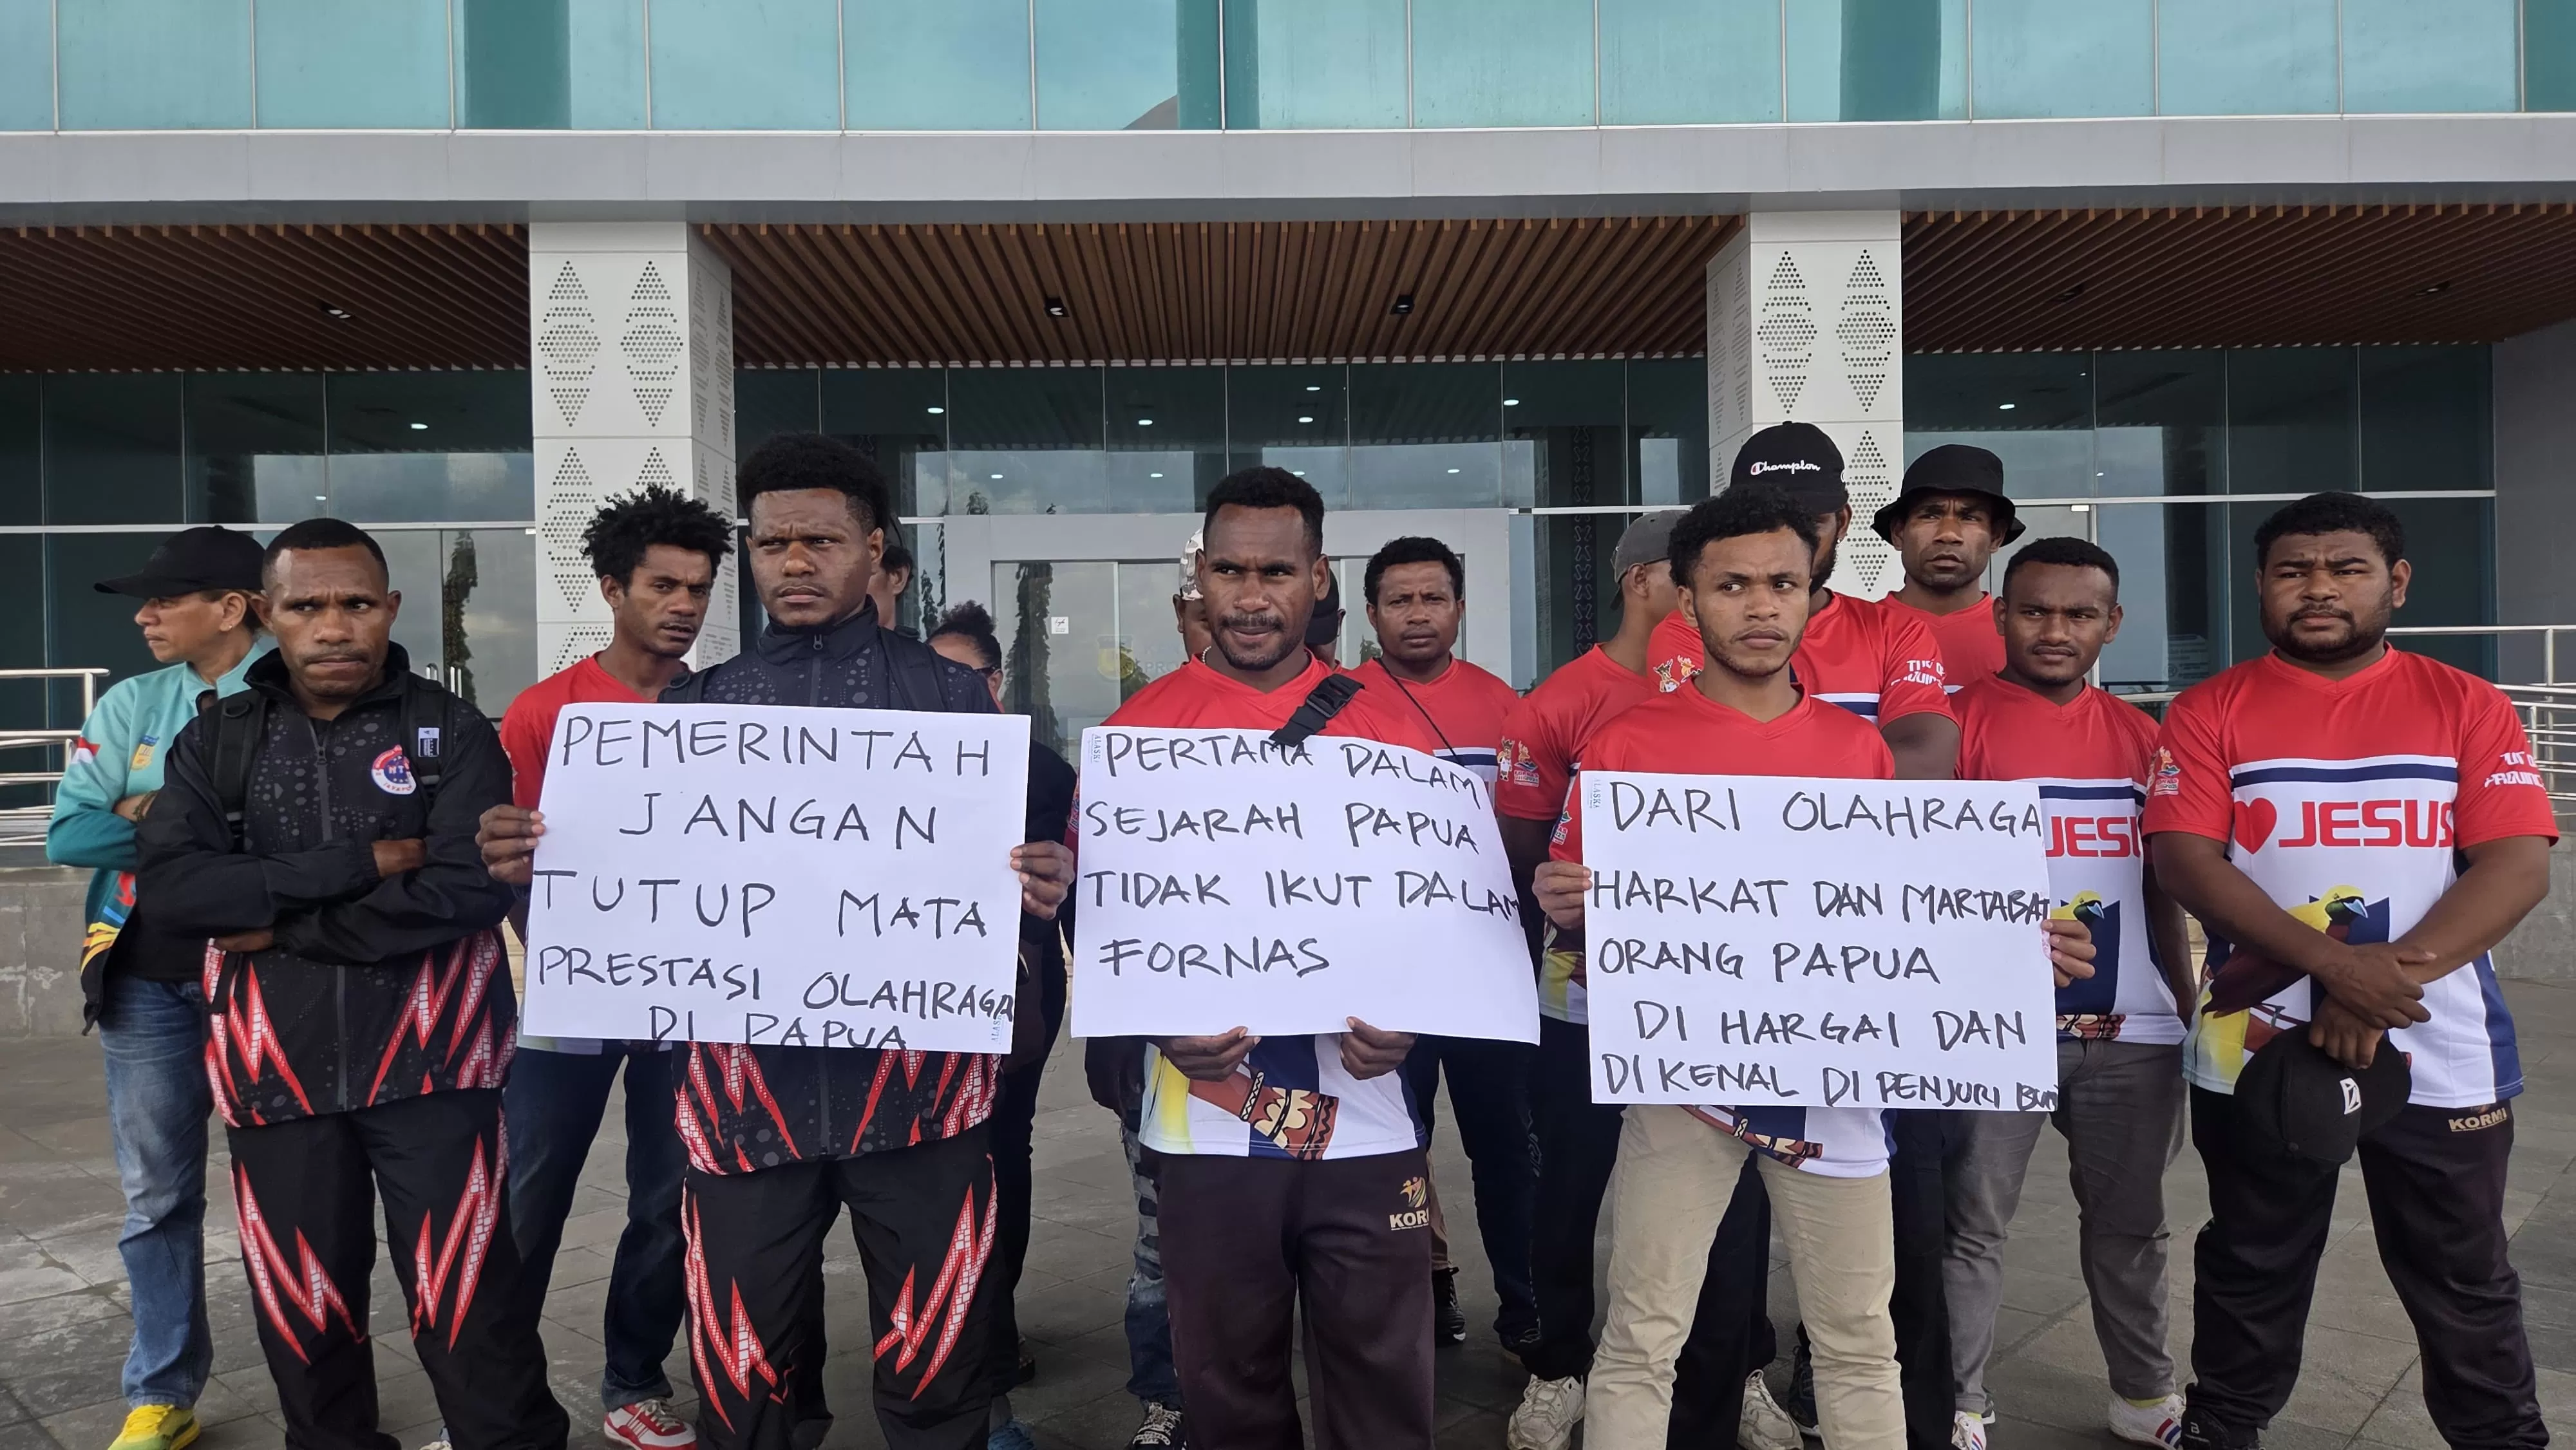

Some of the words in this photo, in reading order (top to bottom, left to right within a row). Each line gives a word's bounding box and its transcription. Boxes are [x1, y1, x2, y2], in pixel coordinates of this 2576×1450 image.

[1750, 460, 1821, 475] Champion
[563, 716, 989, 777] PEMERINTAH
[1106, 733, 1314, 777] PERTAMA
[1340, 743, 1480, 809] DALAM
[619, 793, 936, 849] JANGAN
[1086, 802, 1303, 842] SEJARAH
[1346, 802, 1479, 854] PAPUA
[1609, 782, 1740, 832] DARI
[1783, 791, 2041, 838] OLAHRAGA
[2278, 799, 2454, 848] JESUS
[533, 871, 775, 937] TUTUP
[839, 889, 986, 938] MATA
[1085, 872, 1231, 908] TIDAK
[1265, 870, 1372, 907] IKUT
[1593, 871, 1788, 913] HARKAT
[1814, 881, 1882, 918] DAN
[1902, 884, 2049, 925] MARTABAT
[1099, 936, 1330, 978] FORNAS
[1598, 937, 1743, 980] ORANG
[1773, 943, 1940, 984] PAPUA
[539, 946, 761, 1001] PRESTASI
[803, 972, 1014, 1022] OLAHRAGA
[649, 1006, 693, 1041] DI
[746, 1013, 907, 1050] PAPUA
[1634, 1001, 1685, 1040] DI
[1721, 1011, 1899, 1048] HARGAI
[1932, 1011, 2026, 1051] DAN
[1823, 1067, 1860, 1107] DI
[1877, 1071, 2000, 1108] PENJURI
[2448, 1107, 2507, 1131] KORMI
[1389, 1207, 1429, 1229] KOR
